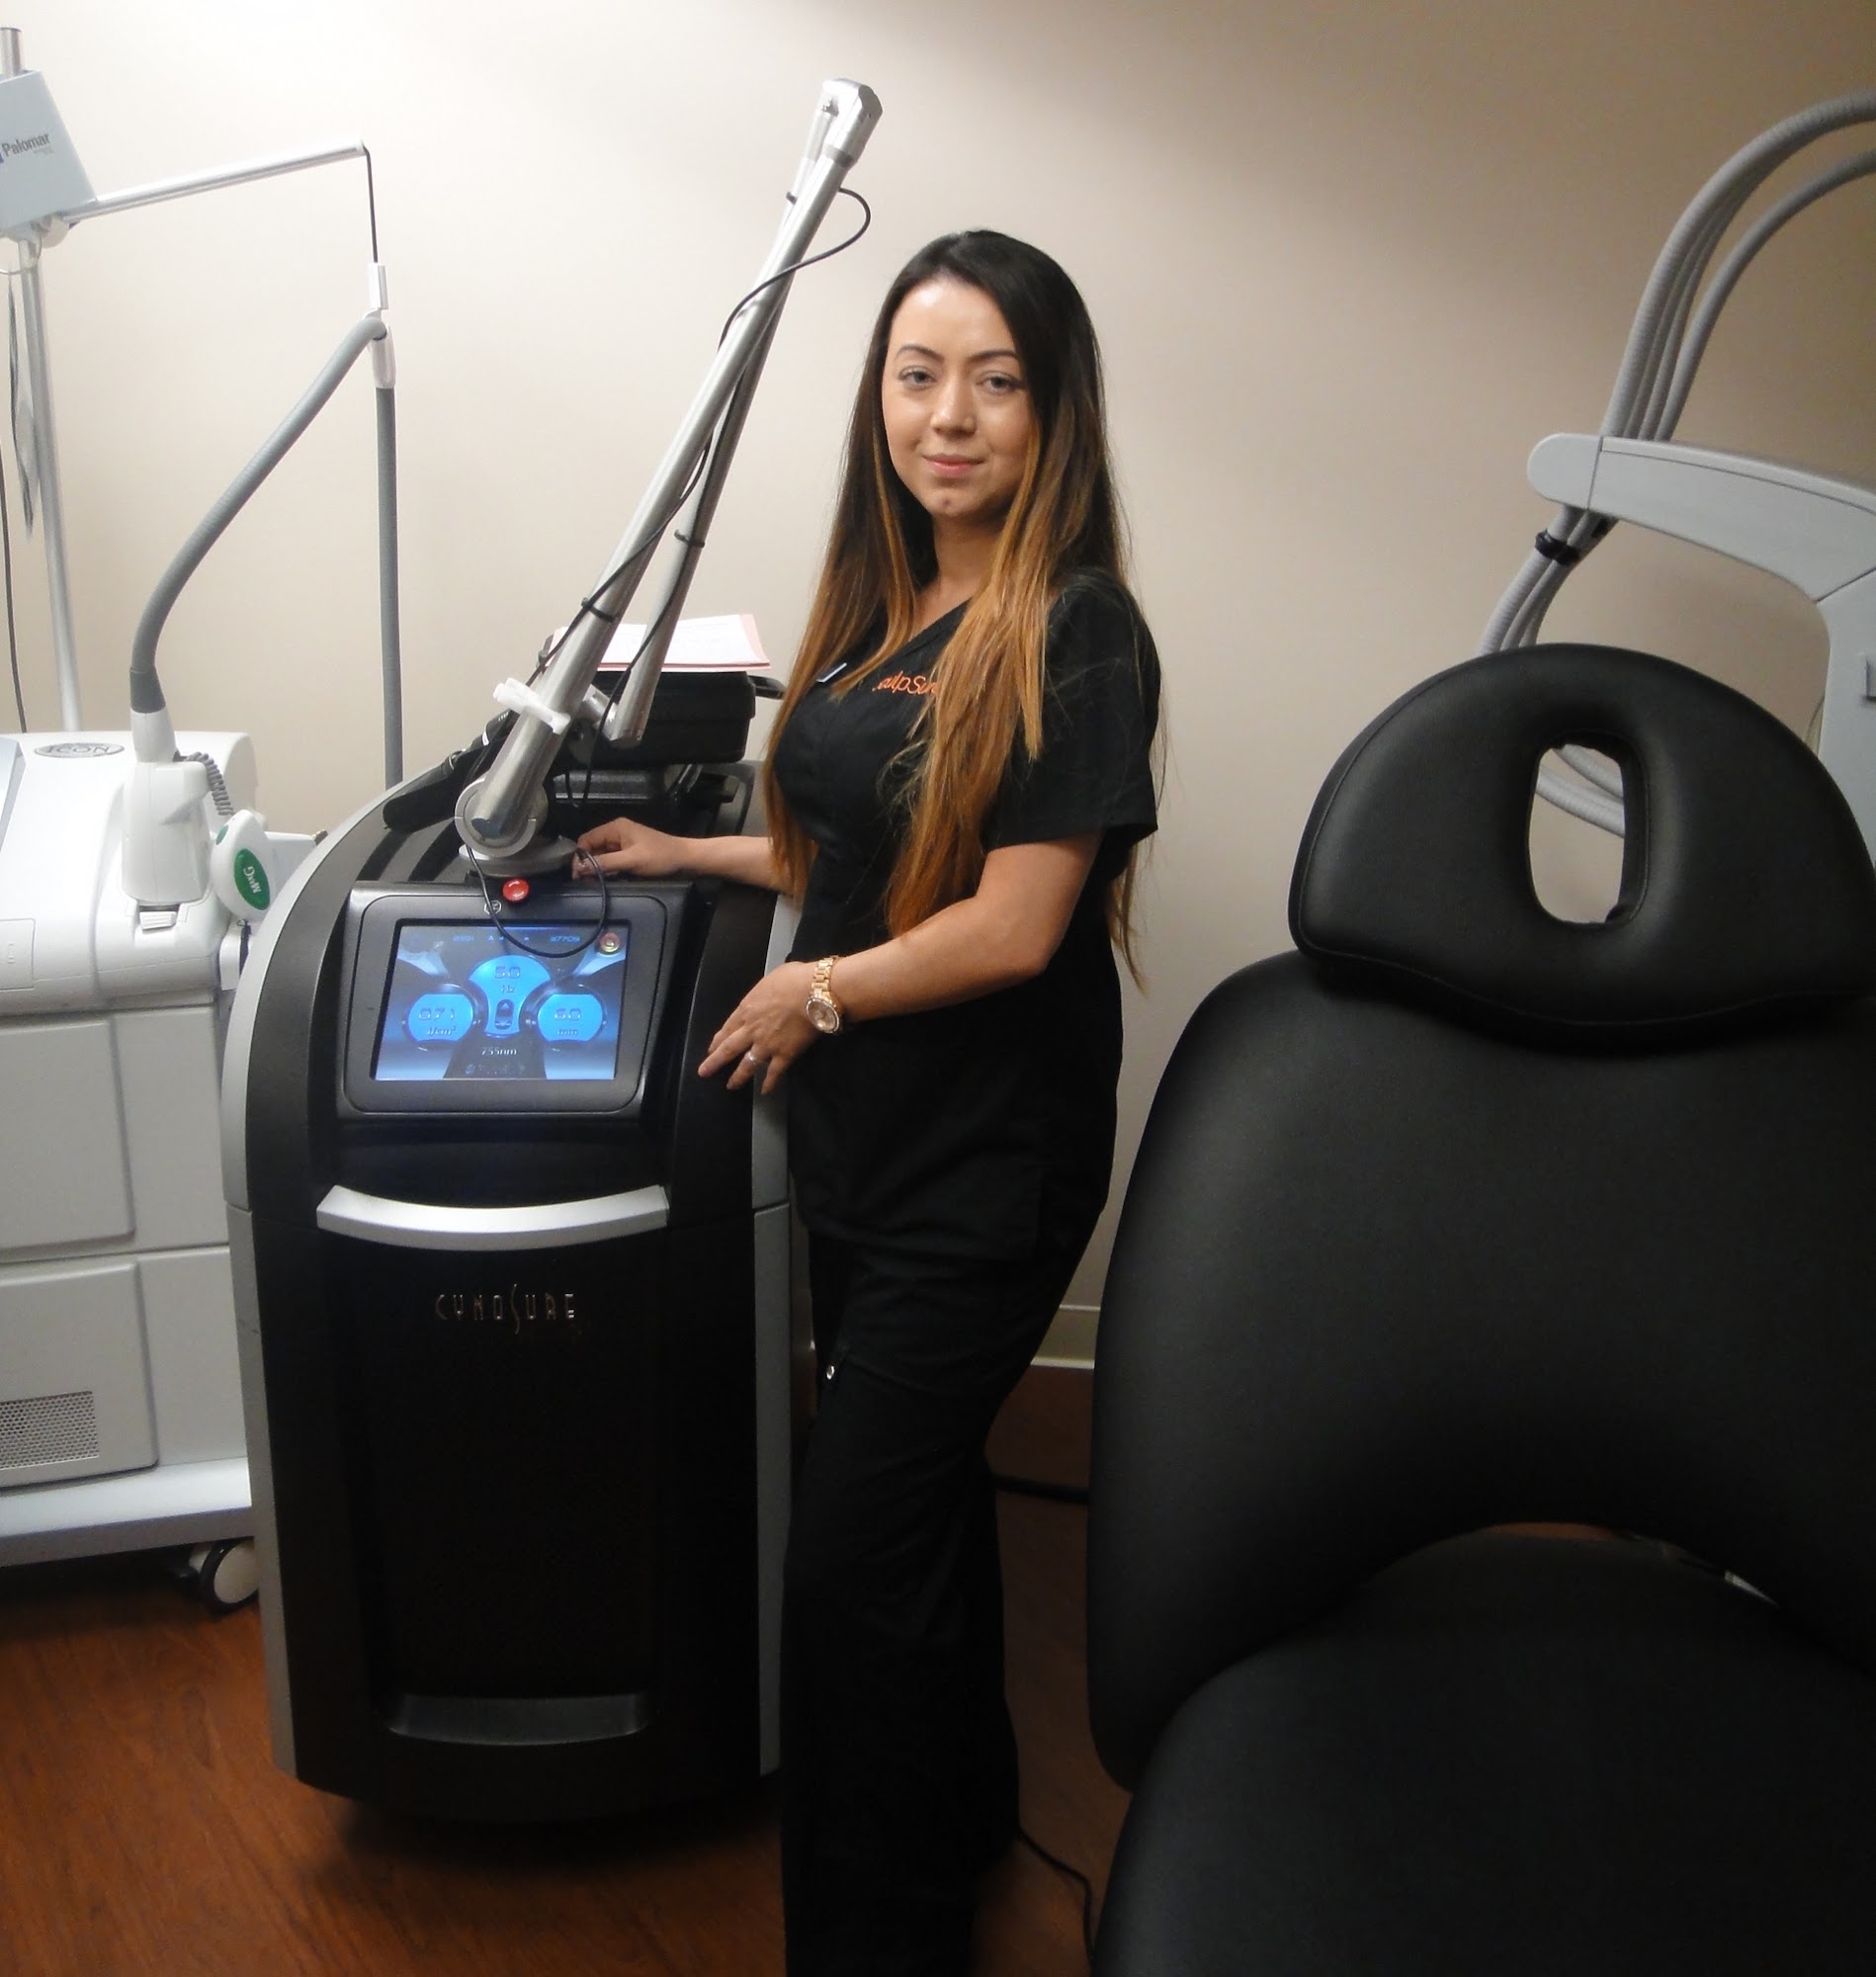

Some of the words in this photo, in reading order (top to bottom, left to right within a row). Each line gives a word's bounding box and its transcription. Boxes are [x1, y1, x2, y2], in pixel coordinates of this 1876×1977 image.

[1, 133, 50, 157] Palomar
[47, 745, 110, 754] ICON
[435, 1284, 574, 1333] CYNOSURE
